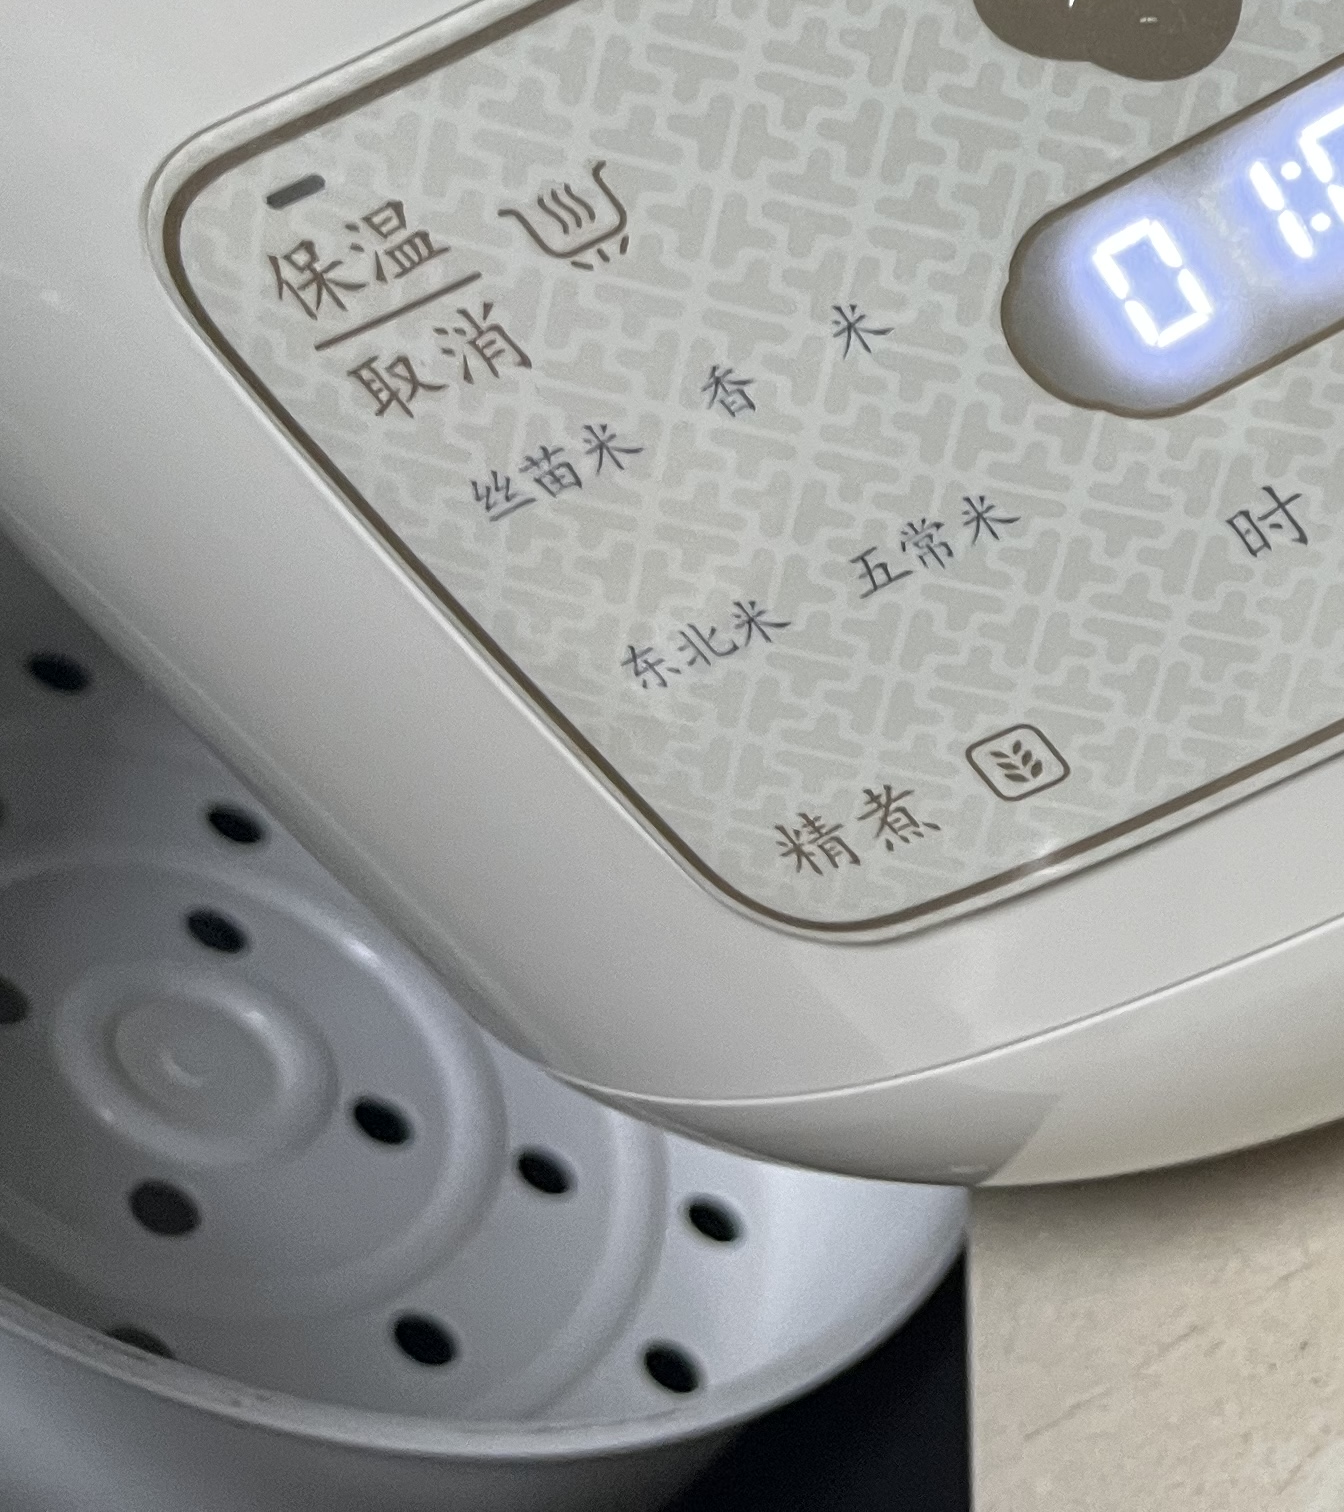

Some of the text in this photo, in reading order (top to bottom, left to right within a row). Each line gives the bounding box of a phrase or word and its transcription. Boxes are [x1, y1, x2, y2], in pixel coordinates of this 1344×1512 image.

[267, 200, 450, 320] 保温
[348, 302, 532, 419] 取消
[701, 303, 895, 417] 香米
[471, 423, 644, 521] 丝苗米
[1226, 485, 1309, 557] 时
[850, 495, 1020, 599] 五常米
[620, 599, 792, 690] 东北米
[774, 784, 940, 875] 精煮
